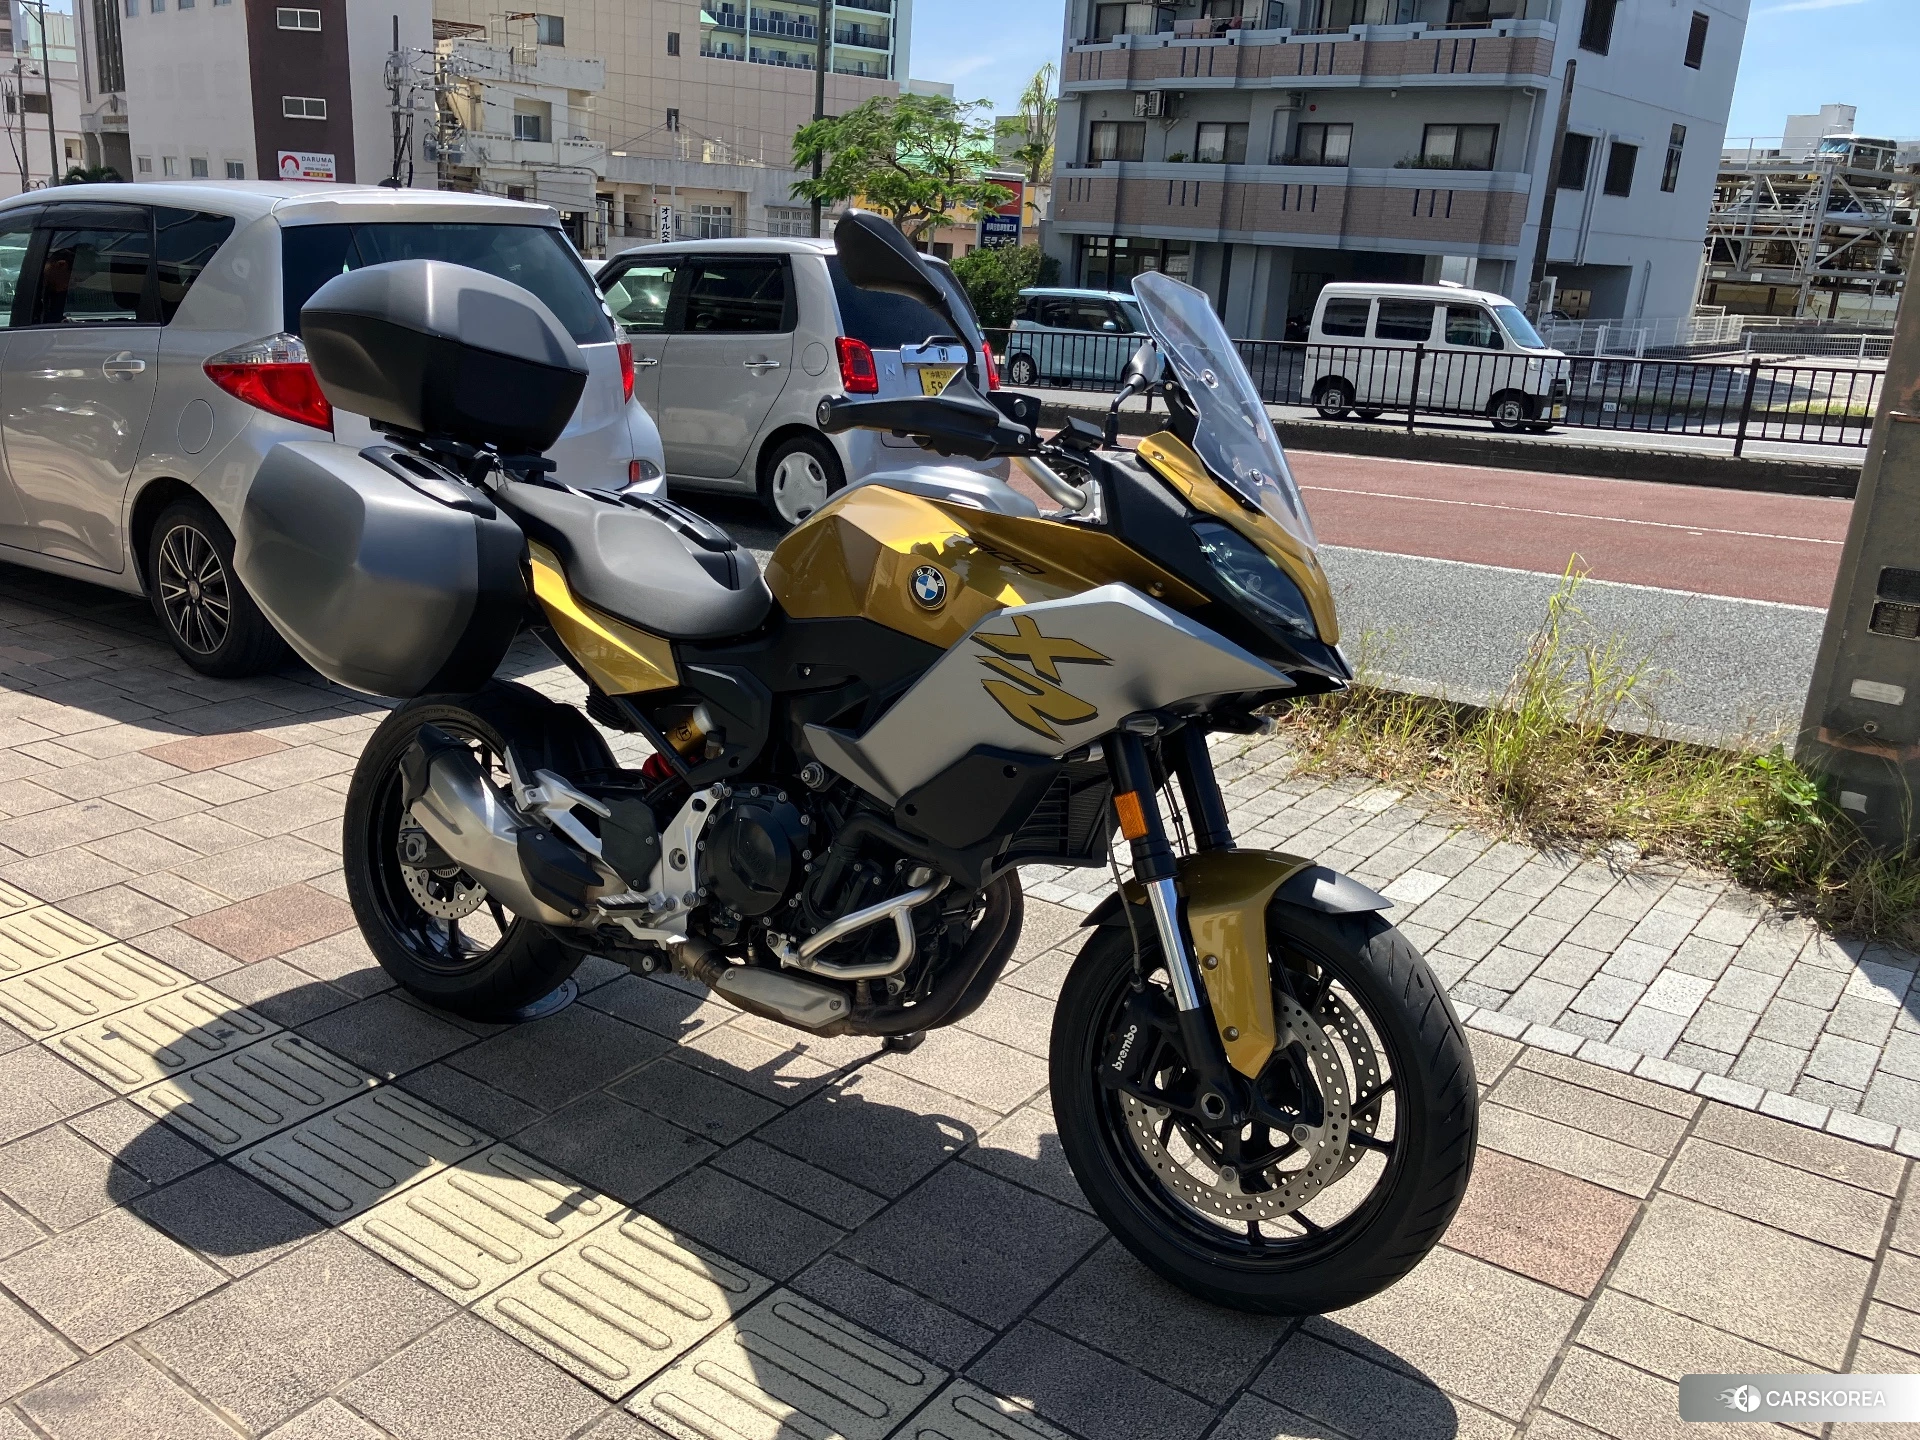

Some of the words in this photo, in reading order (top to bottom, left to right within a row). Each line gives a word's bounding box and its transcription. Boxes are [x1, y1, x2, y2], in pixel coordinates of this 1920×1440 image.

[301, 156, 333, 164] DARUMA
[916, 568, 944, 587] BMW
[968, 614, 1115, 745] XR
[1111, 1024, 1138, 1071] brembo
